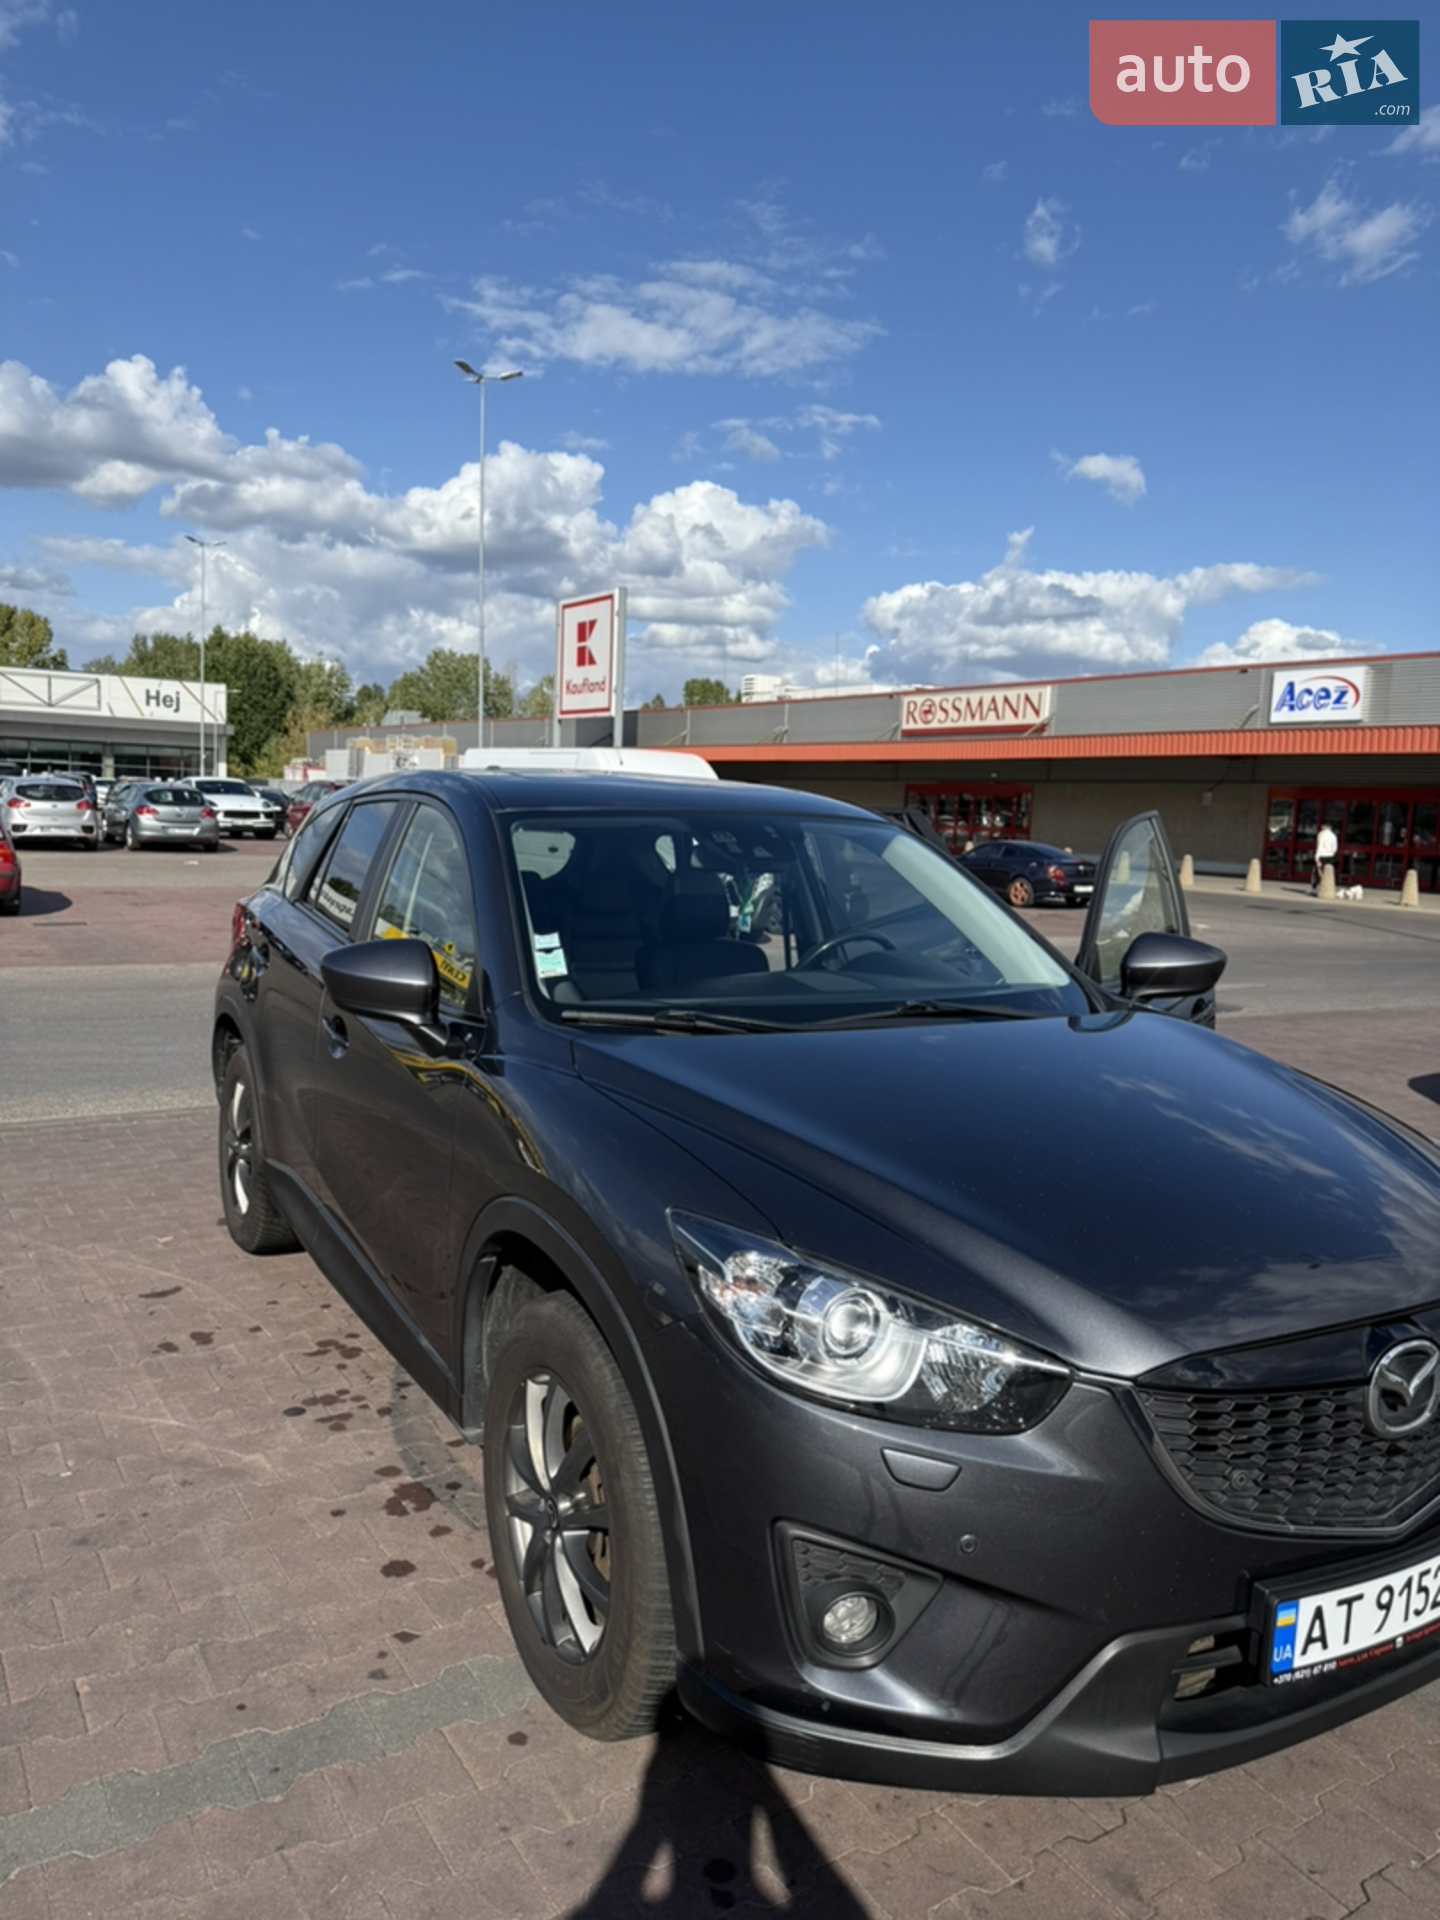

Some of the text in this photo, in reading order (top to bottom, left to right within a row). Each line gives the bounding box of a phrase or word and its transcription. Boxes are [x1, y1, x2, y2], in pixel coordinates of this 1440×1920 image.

[565, 677, 606, 695] Kaufland
[1274, 681, 1349, 712] Acez
[145, 689, 180, 713] Hej
[905, 692, 1042, 725] ROSSMANN
[1300, 1593, 1365, 1657] AT
[1273, 1644, 1292, 1662] UA
